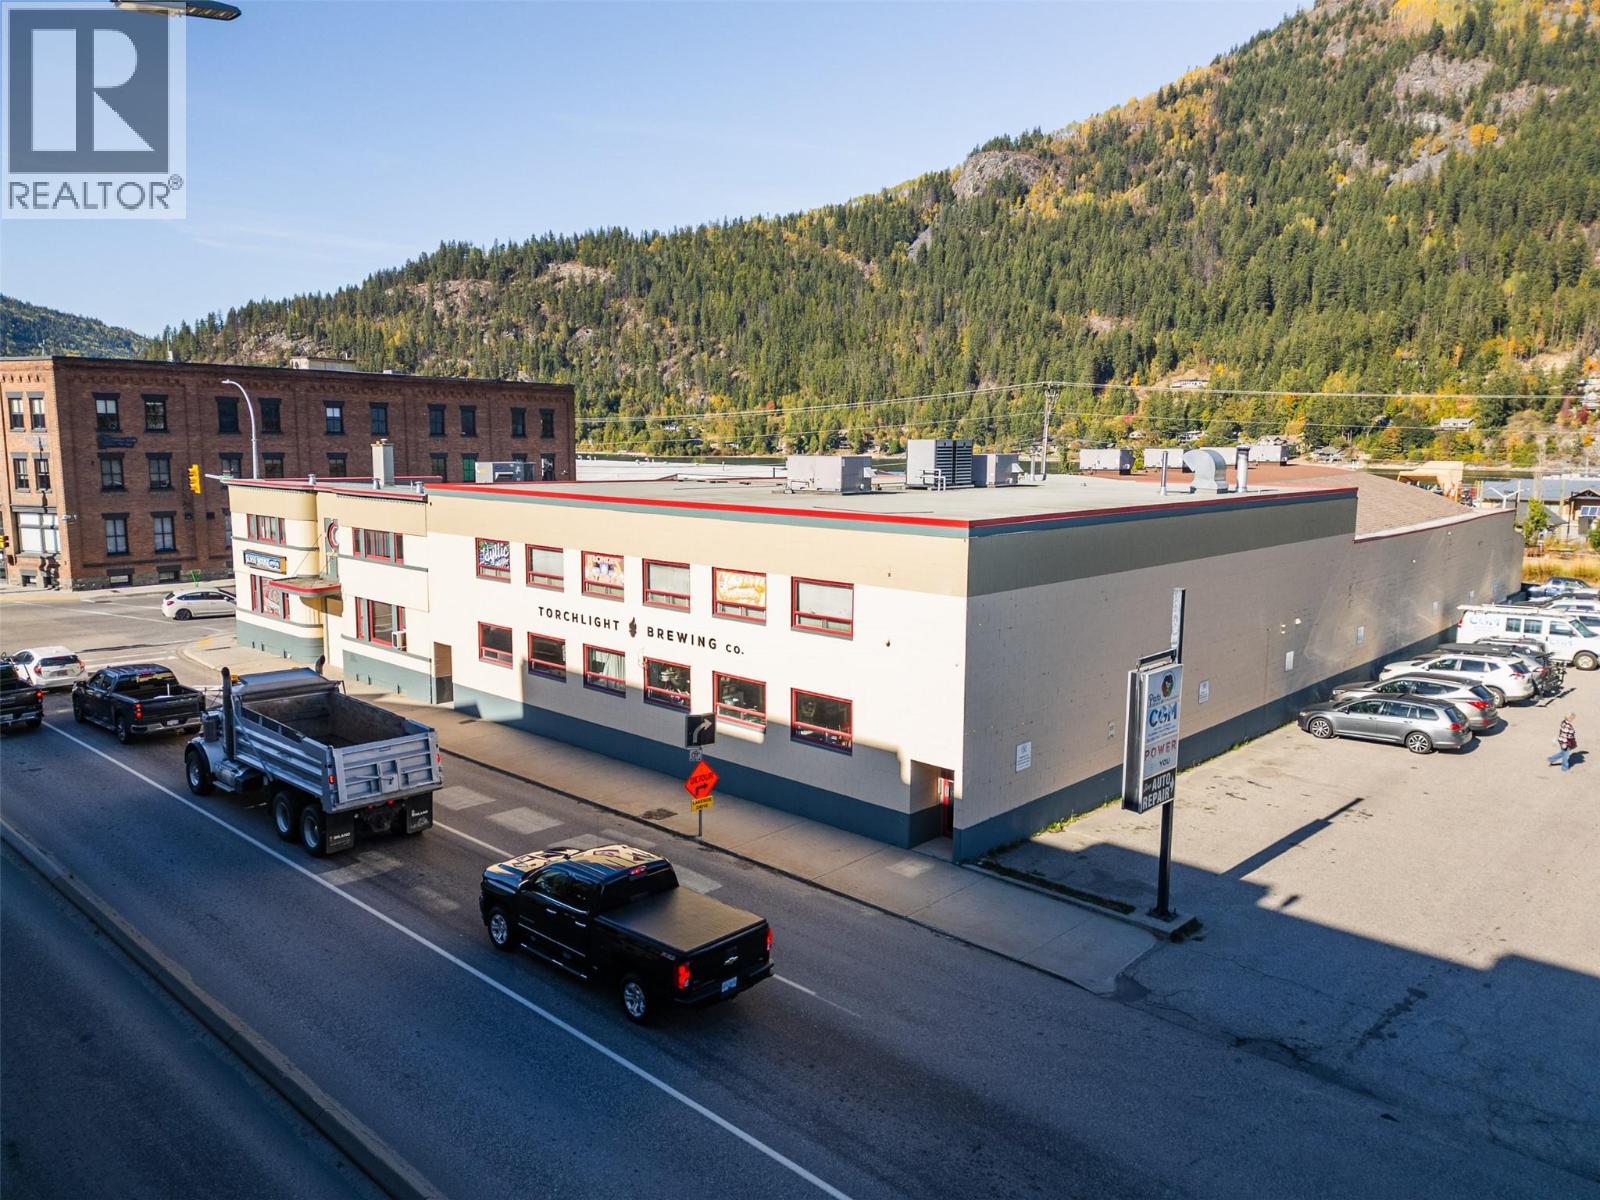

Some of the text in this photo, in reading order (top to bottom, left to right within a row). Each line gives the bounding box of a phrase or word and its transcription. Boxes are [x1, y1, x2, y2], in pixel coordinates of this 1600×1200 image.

[480, 543, 510, 564] Idyllic
[538, 606, 744, 655] TORCHLIGHT BREWING CO.
[1149, 702, 1177, 728] CGM
[1144, 740, 1177, 761] POWER
[1151, 772, 1171, 792] AUTO
[1142, 787, 1170, 811] REPAIR
